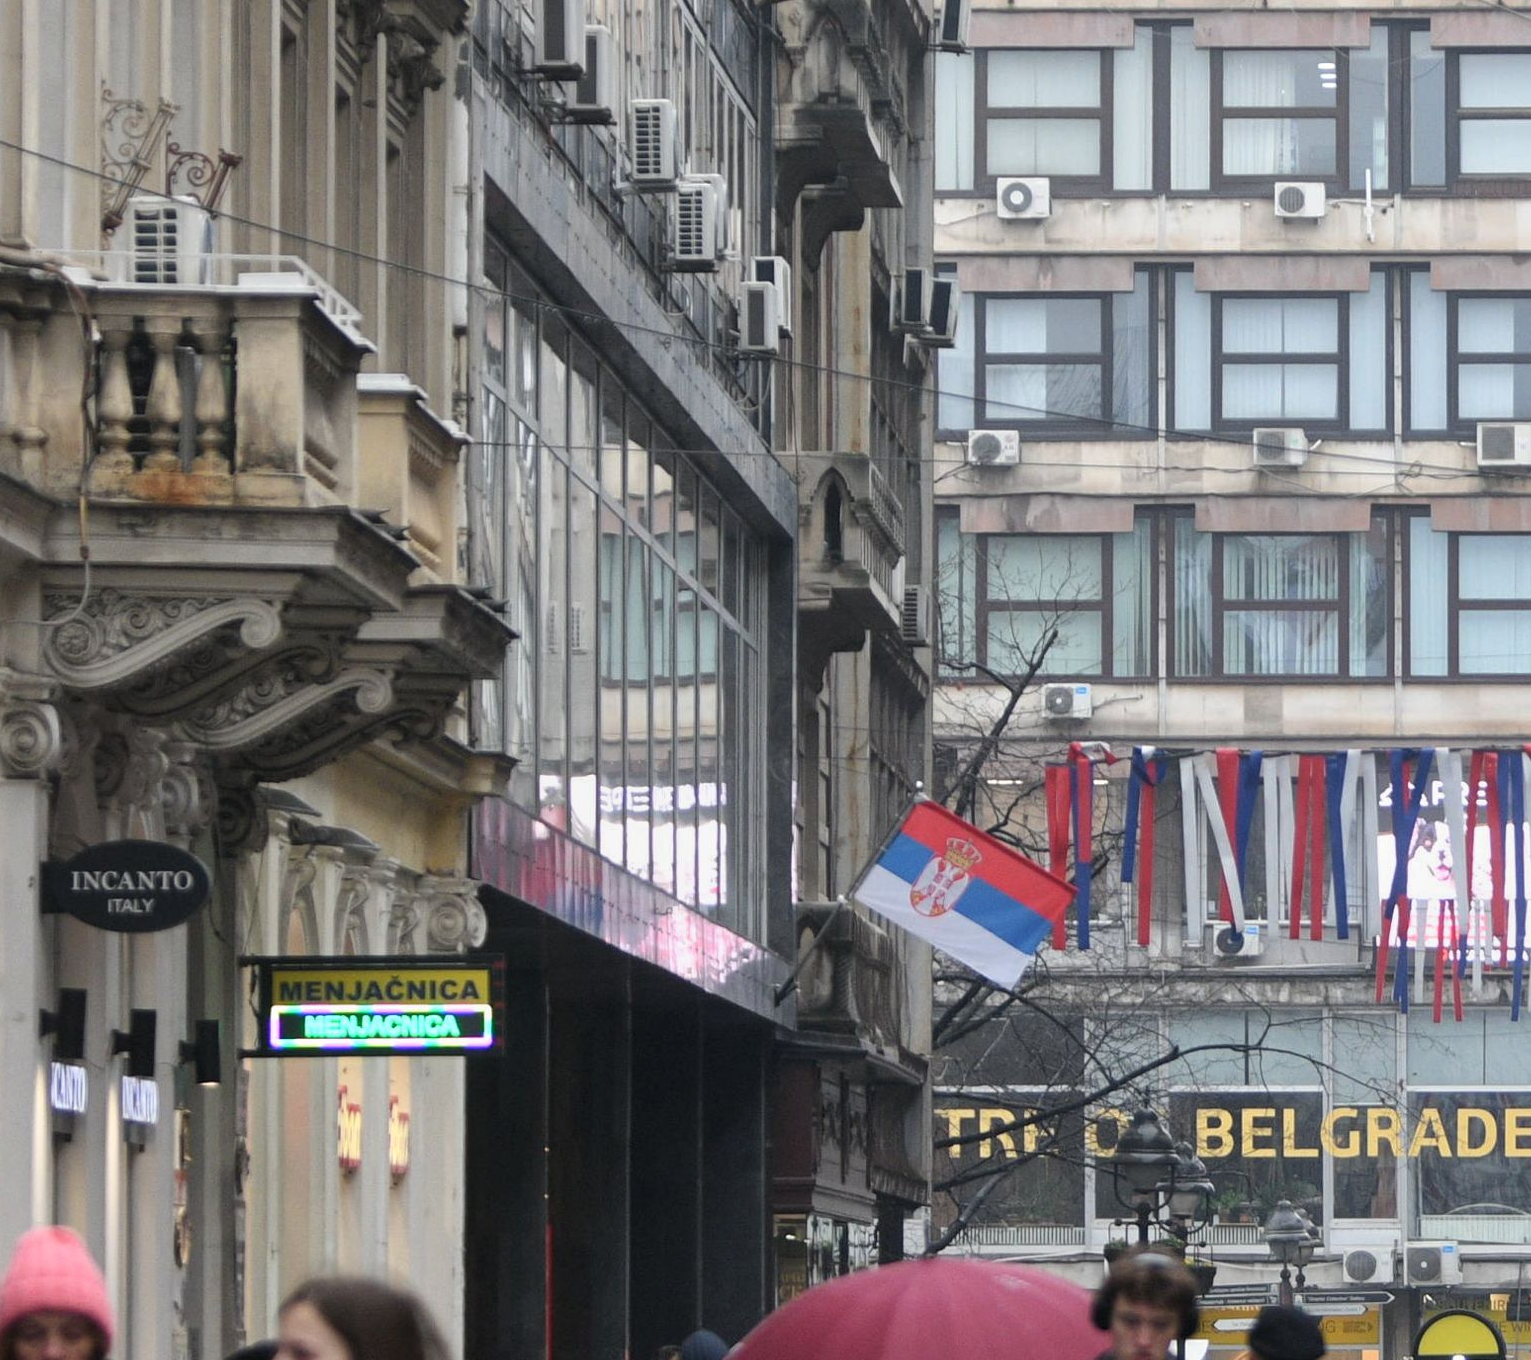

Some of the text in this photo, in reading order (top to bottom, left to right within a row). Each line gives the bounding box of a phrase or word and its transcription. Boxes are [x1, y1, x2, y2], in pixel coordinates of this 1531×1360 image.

[71, 870, 195, 891] INCANTO
[107, 897, 155, 913] ITALY
[279, 975, 480, 1001] MENJAČNICA
